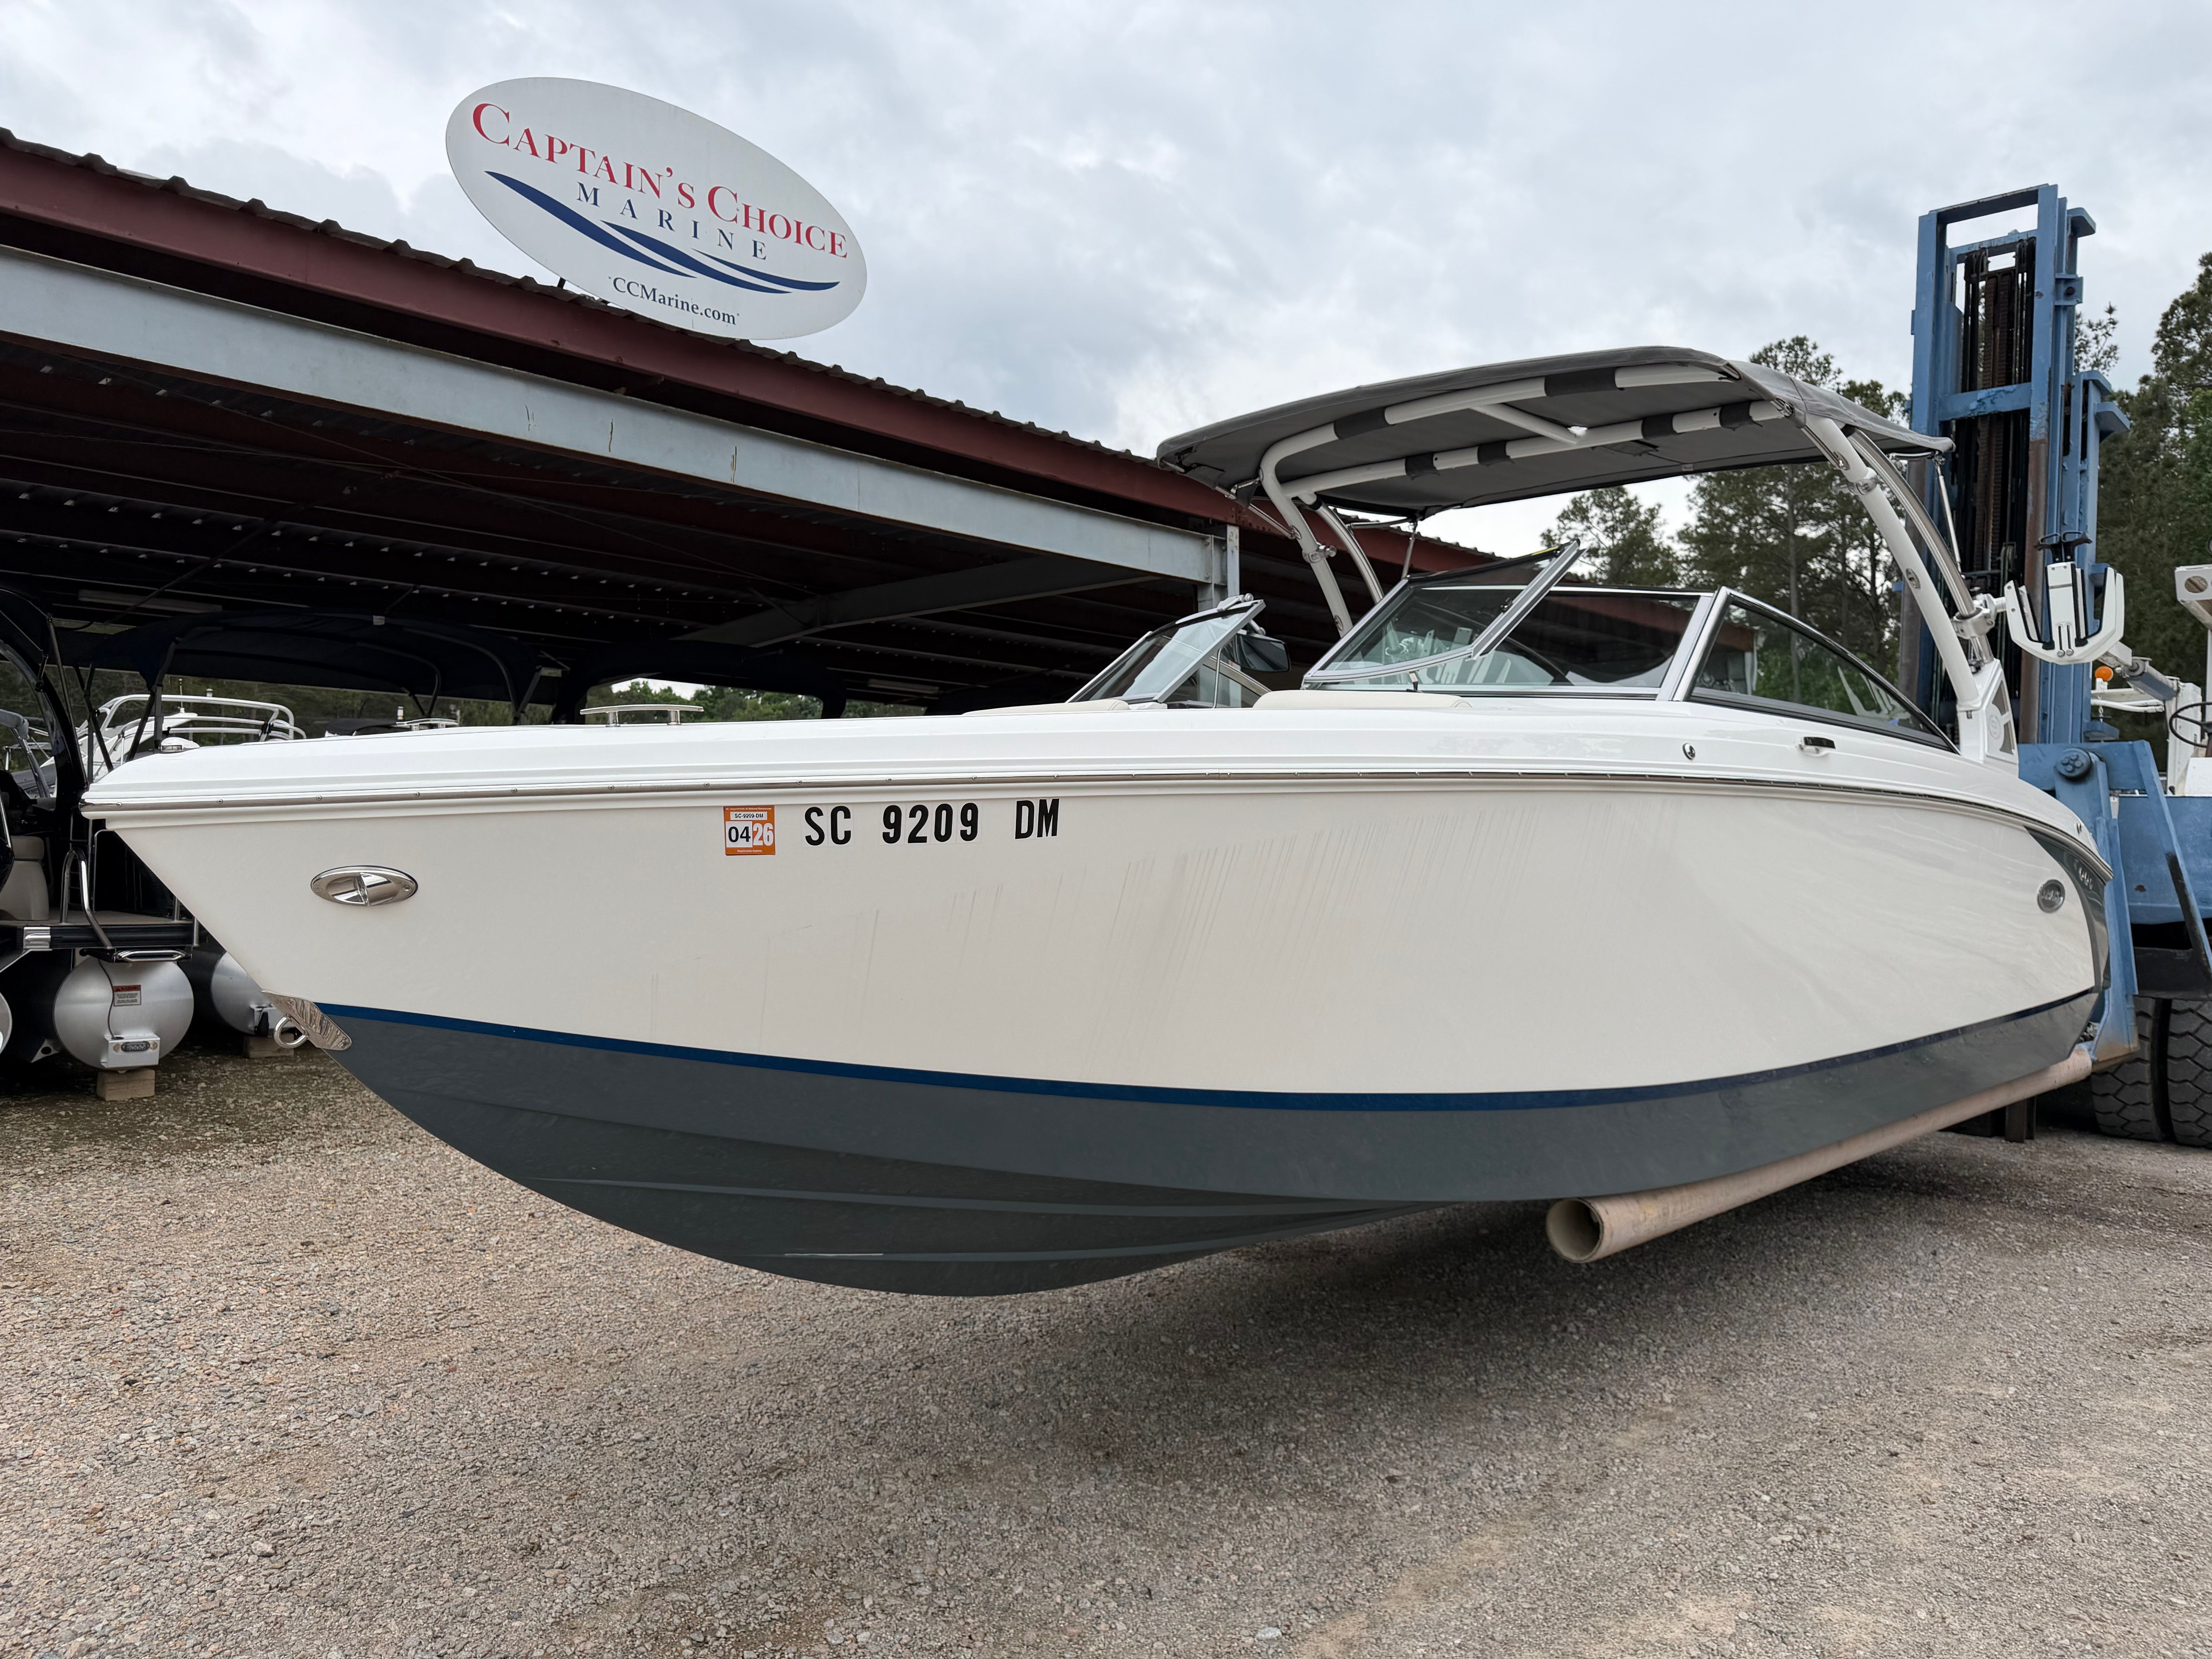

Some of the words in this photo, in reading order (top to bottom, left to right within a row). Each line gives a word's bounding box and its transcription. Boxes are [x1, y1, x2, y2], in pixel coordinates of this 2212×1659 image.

[473, 103, 695, 208] CAPTAIN'S
[708, 186, 848, 258] CHOICE
[576, 181, 767, 260] MARINE
[613, 276, 737, 325] CCMarine.com
[728, 826, 751, 842] 04
[752, 823, 774, 846] 26
[805, 806, 851, 845] SC
[883, 803, 978, 843] 9209
[1015, 799, 1059, 839] DM
